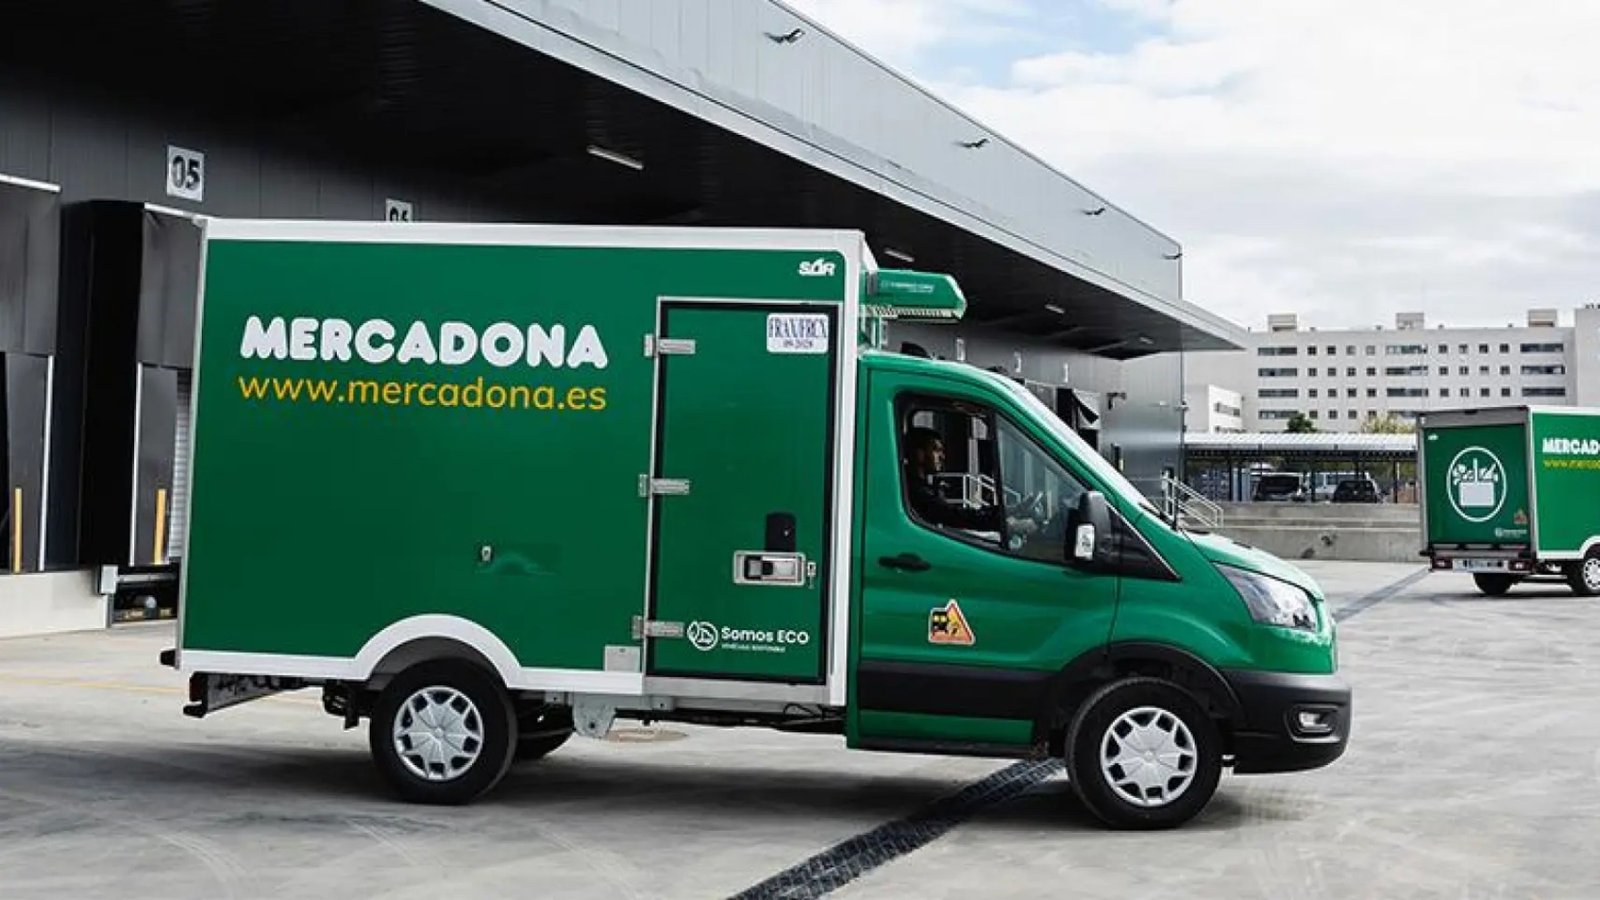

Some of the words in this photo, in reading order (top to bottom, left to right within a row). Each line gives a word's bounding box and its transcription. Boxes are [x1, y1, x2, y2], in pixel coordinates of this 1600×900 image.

[172, 155, 200, 190] 05
[240, 316, 608, 368] MERCADONA
[238, 376, 607, 411] www.mercadona.es
[1542, 437, 1600, 455] MERCAD
[721, 626, 774, 642] Somos
[777, 629, 810, 645] ECO
